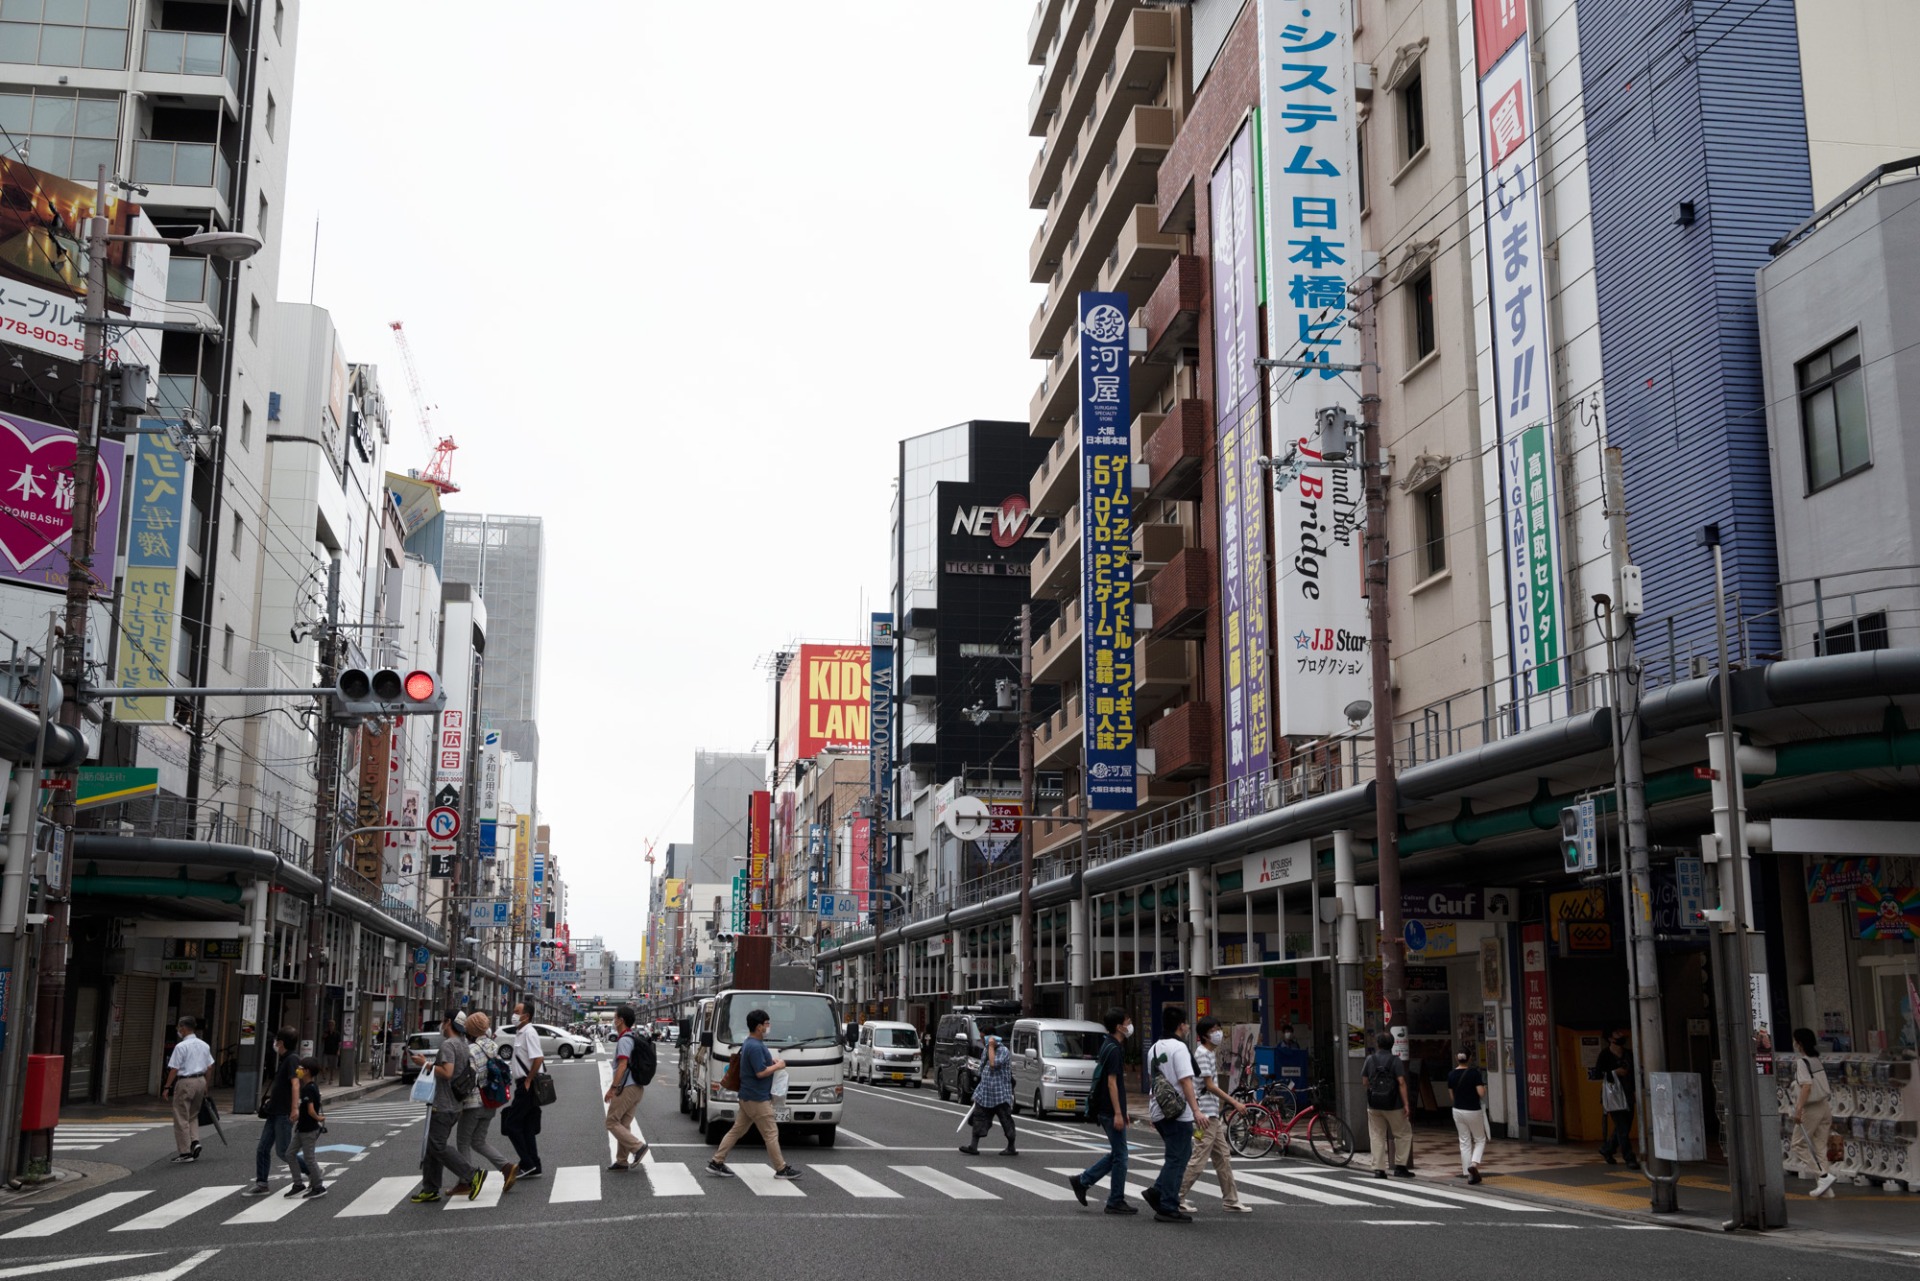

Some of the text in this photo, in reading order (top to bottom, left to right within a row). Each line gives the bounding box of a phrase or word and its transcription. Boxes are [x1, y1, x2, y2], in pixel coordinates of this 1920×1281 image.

[0, 288, 120, 344] メープル
[0, 316, 119, 362] 78-903-50
[1085, 304, 1126, 403] 駿河屋
[1086, 436, 1128, 446] 日本橋本館
[1097, 426, 1116, 436] 大阪
[1333, 510, 1356, 547] Bar
[947, 561, 993, 573] TICKET
[1527, 452, 1551, 667] 高価買取センター
[1336, 628, 1367, 652] Star
[1296, 656, 1364, 676] プロダクション
[809, 704, 870, 741] LAN
[443, 712, 461, 768] 貸広告
[484, 753, 496, 809] 永和信用金庫
[497, 905, 504, 915] P
[824, 897, 832, 908] P
[1428, 893, 1477, 915] Guf
[1573, 927, 1607, 942] GEO
[1527, 1013, 1547, 1026] SHOP
